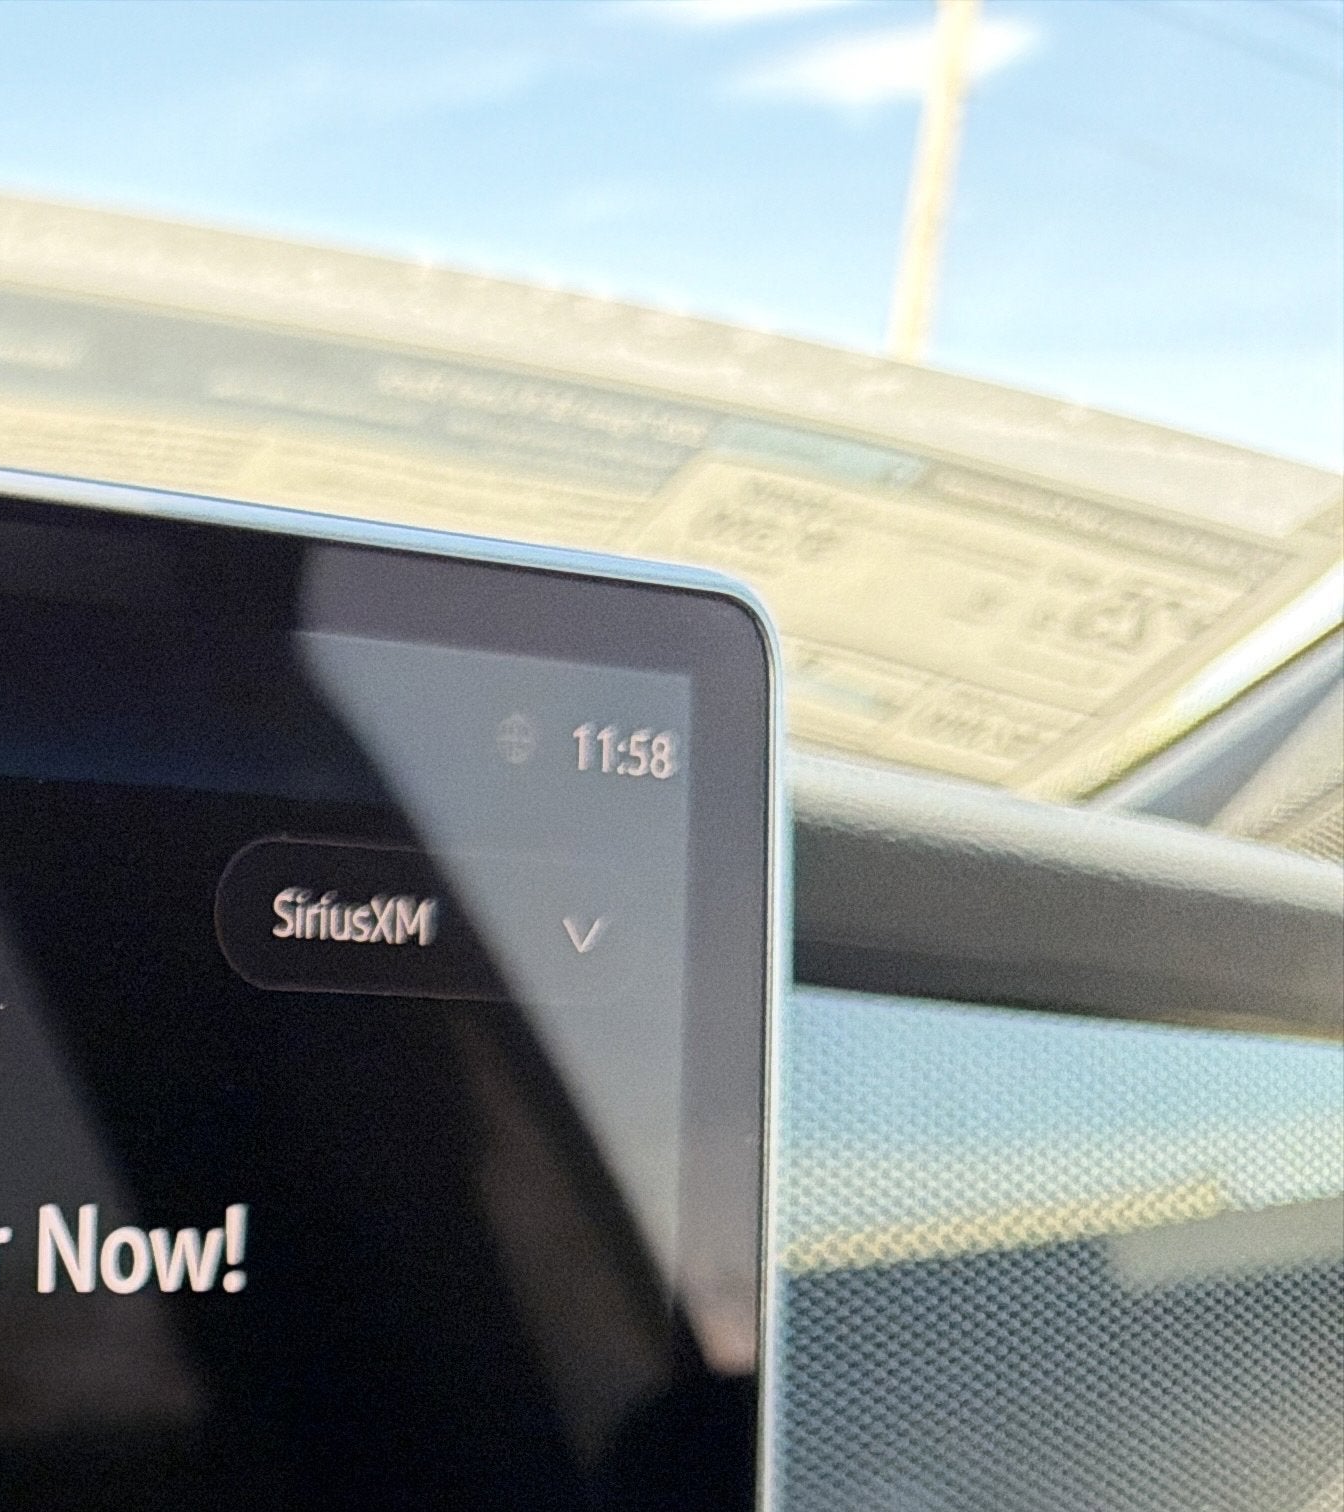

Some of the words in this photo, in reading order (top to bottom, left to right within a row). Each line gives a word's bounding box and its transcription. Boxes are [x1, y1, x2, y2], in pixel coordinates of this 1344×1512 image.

[573, 721, 678, 780] 11:58
[272, 887, 437, 946] SiriusXM
[37, 1202, 250, 1294] Now!
